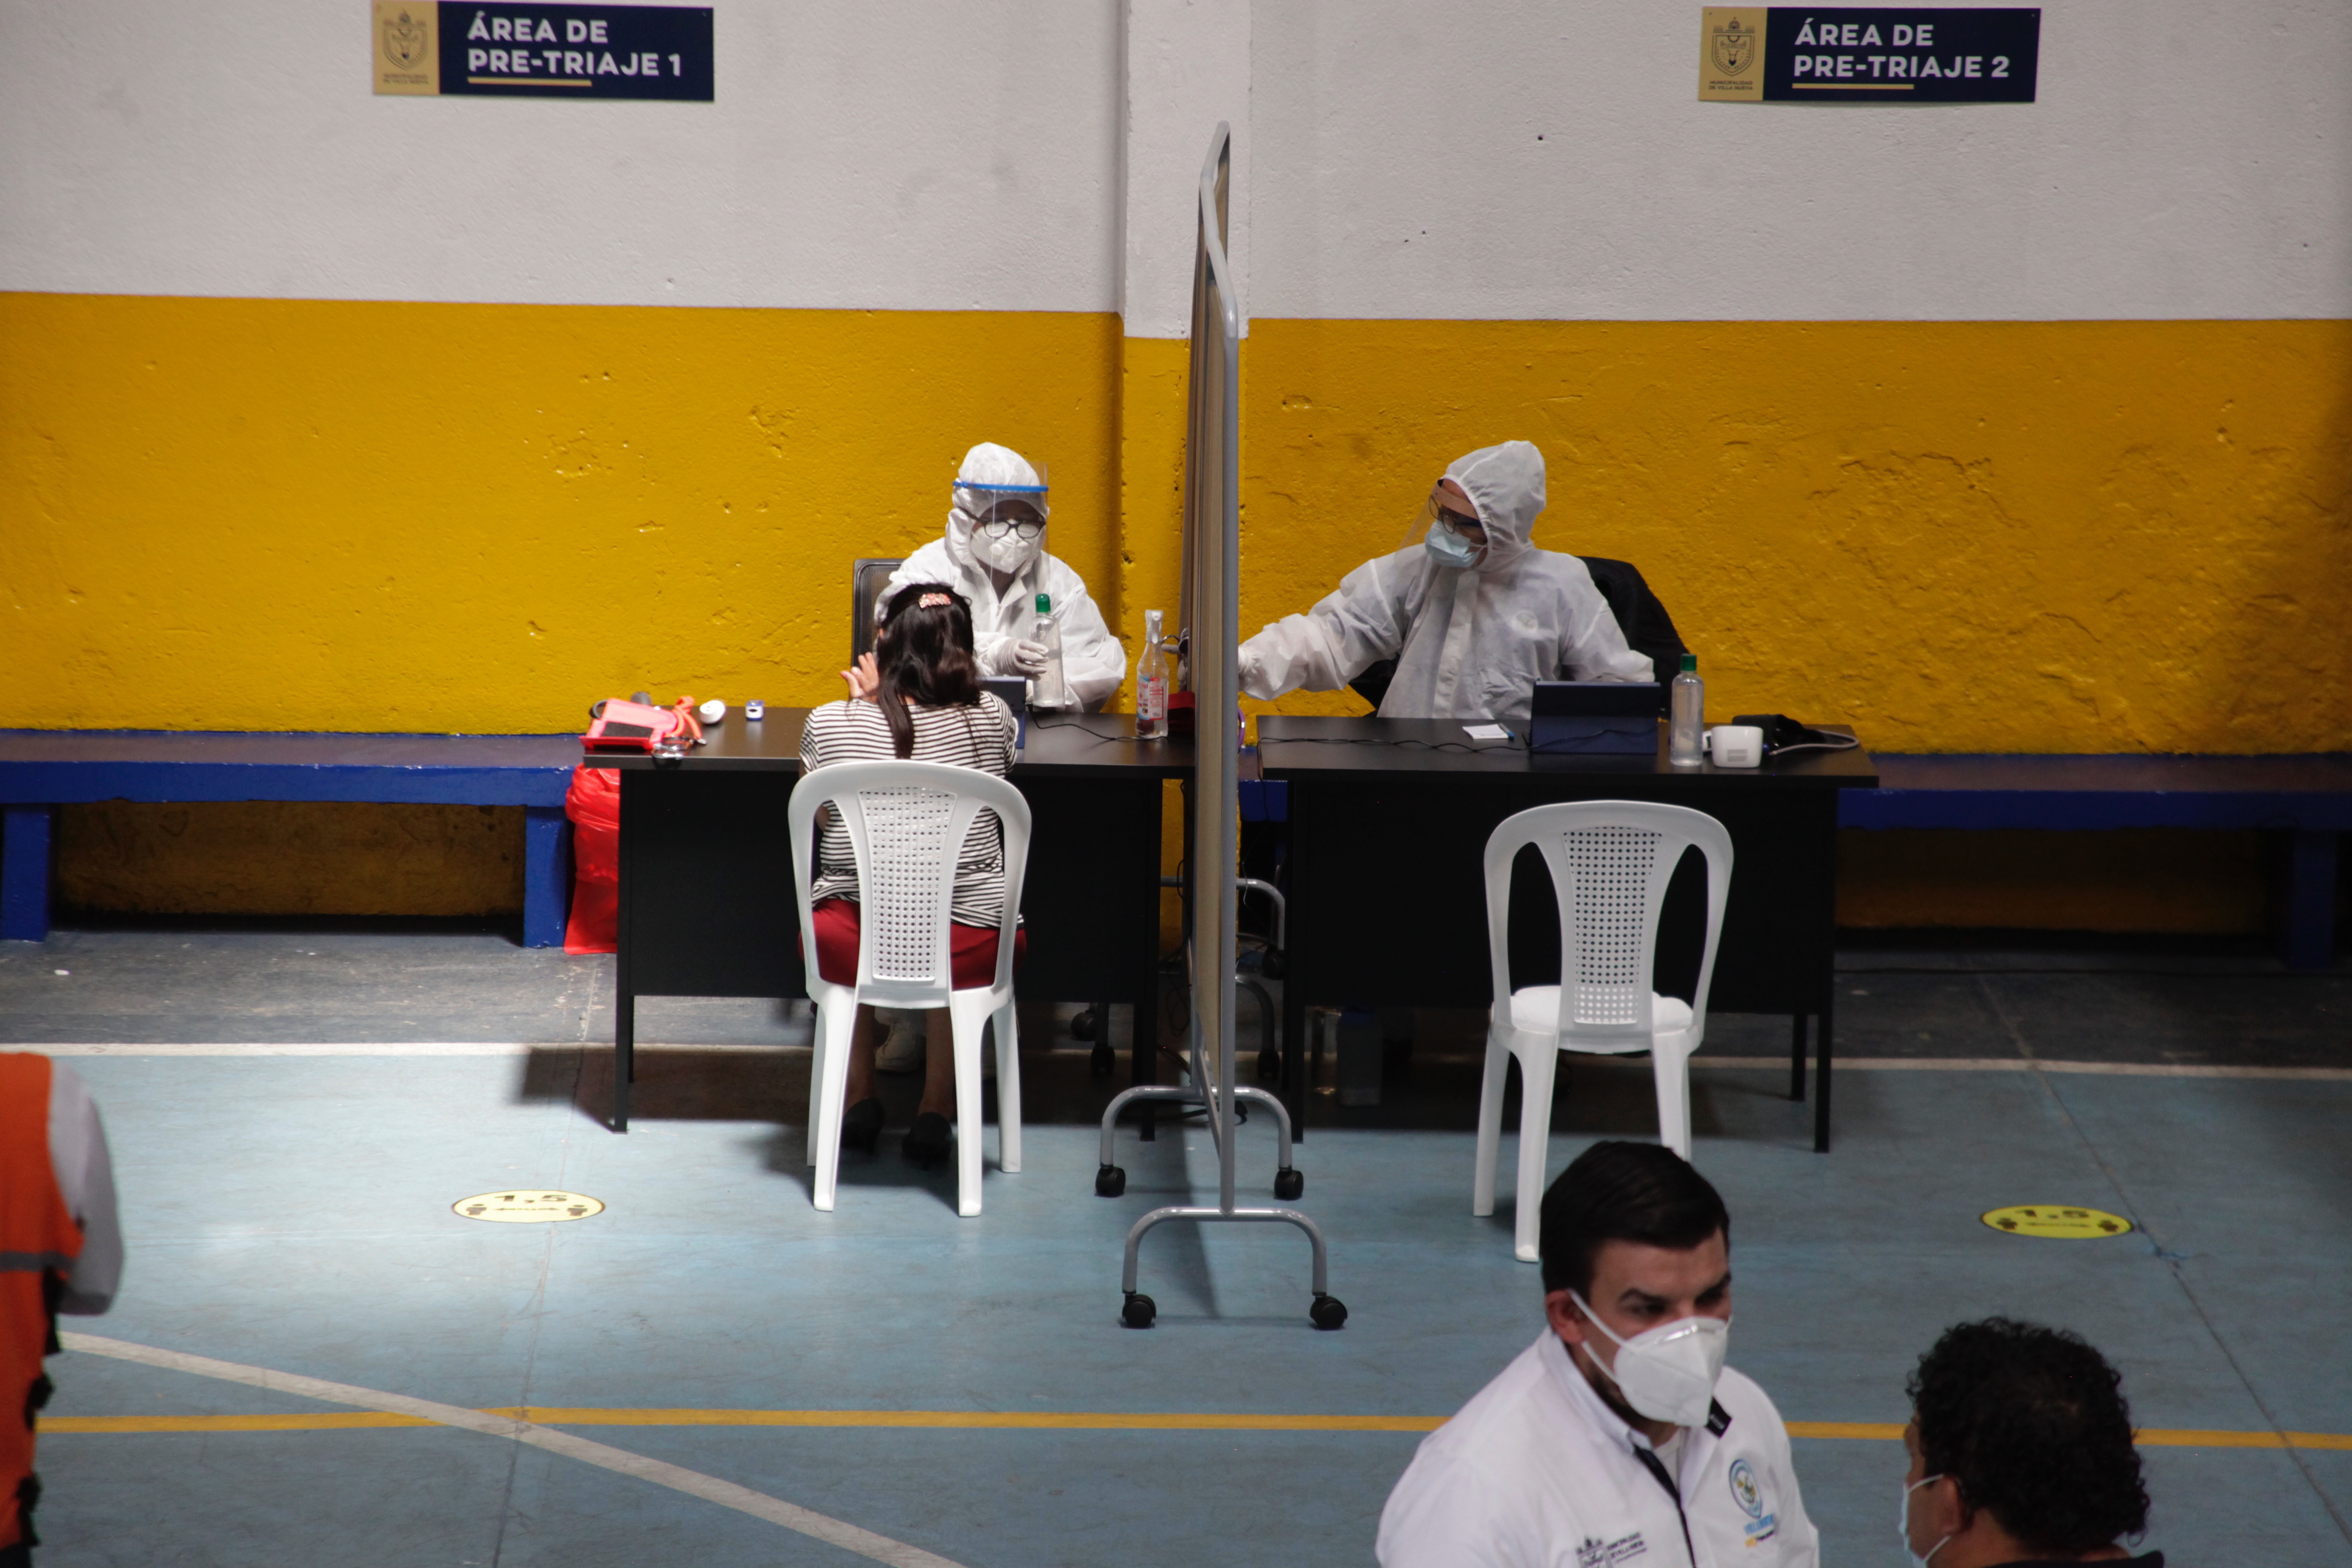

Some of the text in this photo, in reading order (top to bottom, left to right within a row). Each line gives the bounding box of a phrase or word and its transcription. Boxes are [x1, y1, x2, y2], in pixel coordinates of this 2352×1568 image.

[467, 10, 609, 43] ÁREA DE
[1794, 18, 1934, 46] ÁREA DE
[468, 48, 681, 77] PRE-TRIAJE 1
[1794, 55, 2010, 77] PRE-TRIAJE 2
